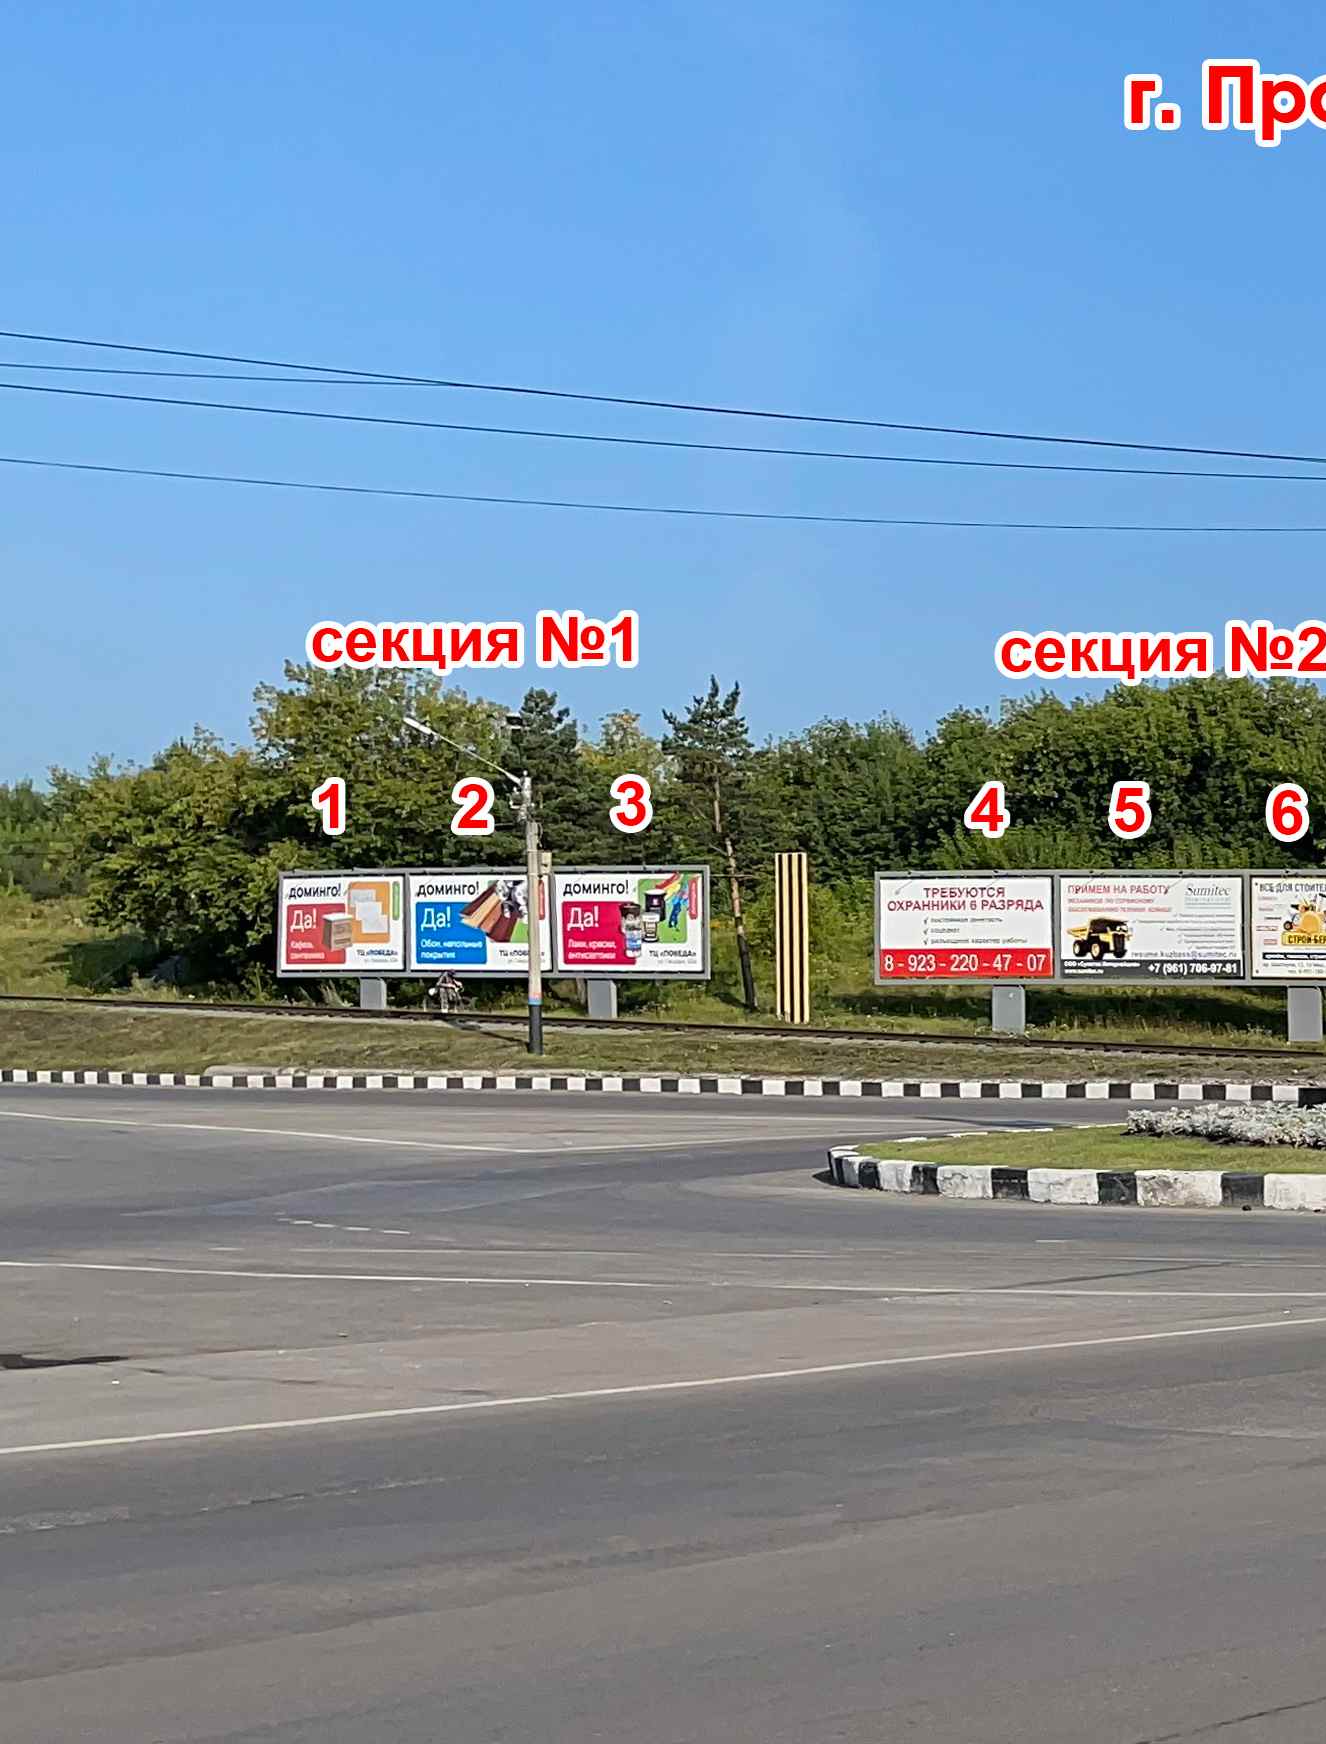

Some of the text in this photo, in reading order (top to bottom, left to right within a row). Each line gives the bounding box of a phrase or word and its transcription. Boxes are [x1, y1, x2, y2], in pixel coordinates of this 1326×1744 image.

[923, 887, 1005, 899] ТРЕБУЮТСЯ
[1067, 884, 1169, 895] ПРИМЕМ НА РАБОТУ
[1184, 882, 1232, 896] Sumitec
[887, 900, 966, 912] ОХРАННИКИ
[981, 900, 1044, 913] РАЗРЯДА
[290, 908, 317, 933] Да!
[420, 906, 451, 932] Да!
[567, 906, 599, 932] Да!
[1147, 963, 1161, 974] +7
[1162, 963, 1188, 976] (961)
